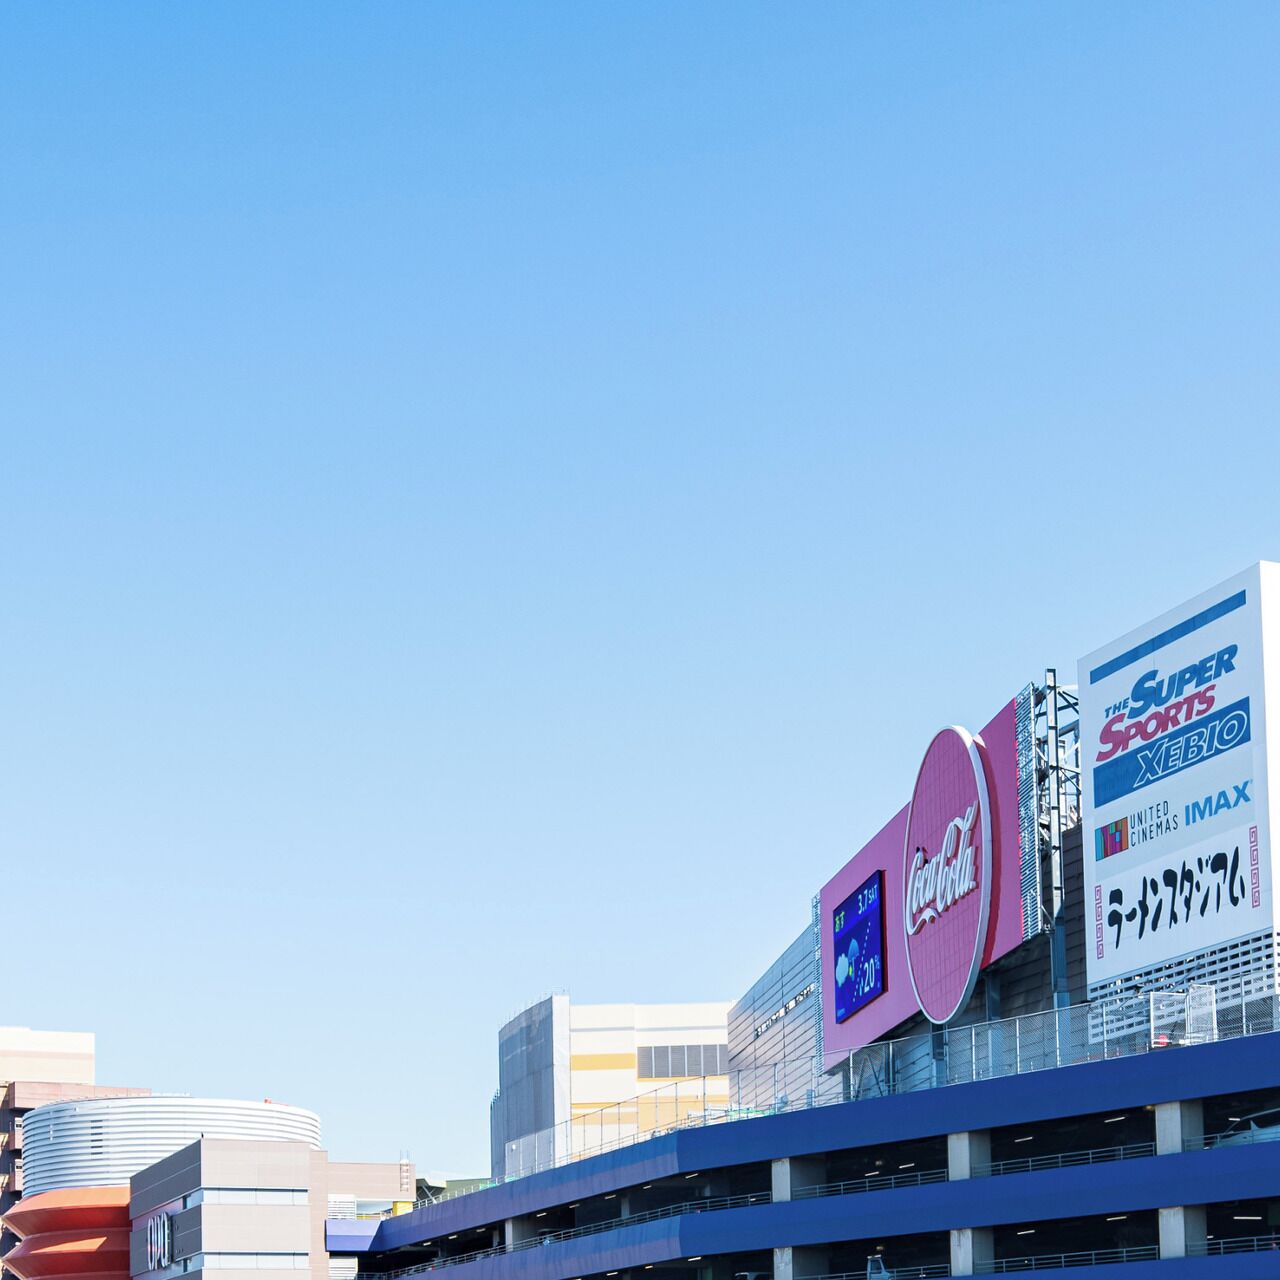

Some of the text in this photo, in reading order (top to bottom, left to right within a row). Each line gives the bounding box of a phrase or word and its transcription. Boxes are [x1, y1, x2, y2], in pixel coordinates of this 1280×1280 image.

[1104, 644, 1239, 719] THE SUPER
[1095, 684, 1217, 762] SPORTS
[1133, 710, 1248, 789] XEBIO
[1129, 800, 1170, 830] UNITED
[1130, 815, 1179, 848] CINEMAS
[1107, 846, 1246, 950] ラーメンスタジアム
